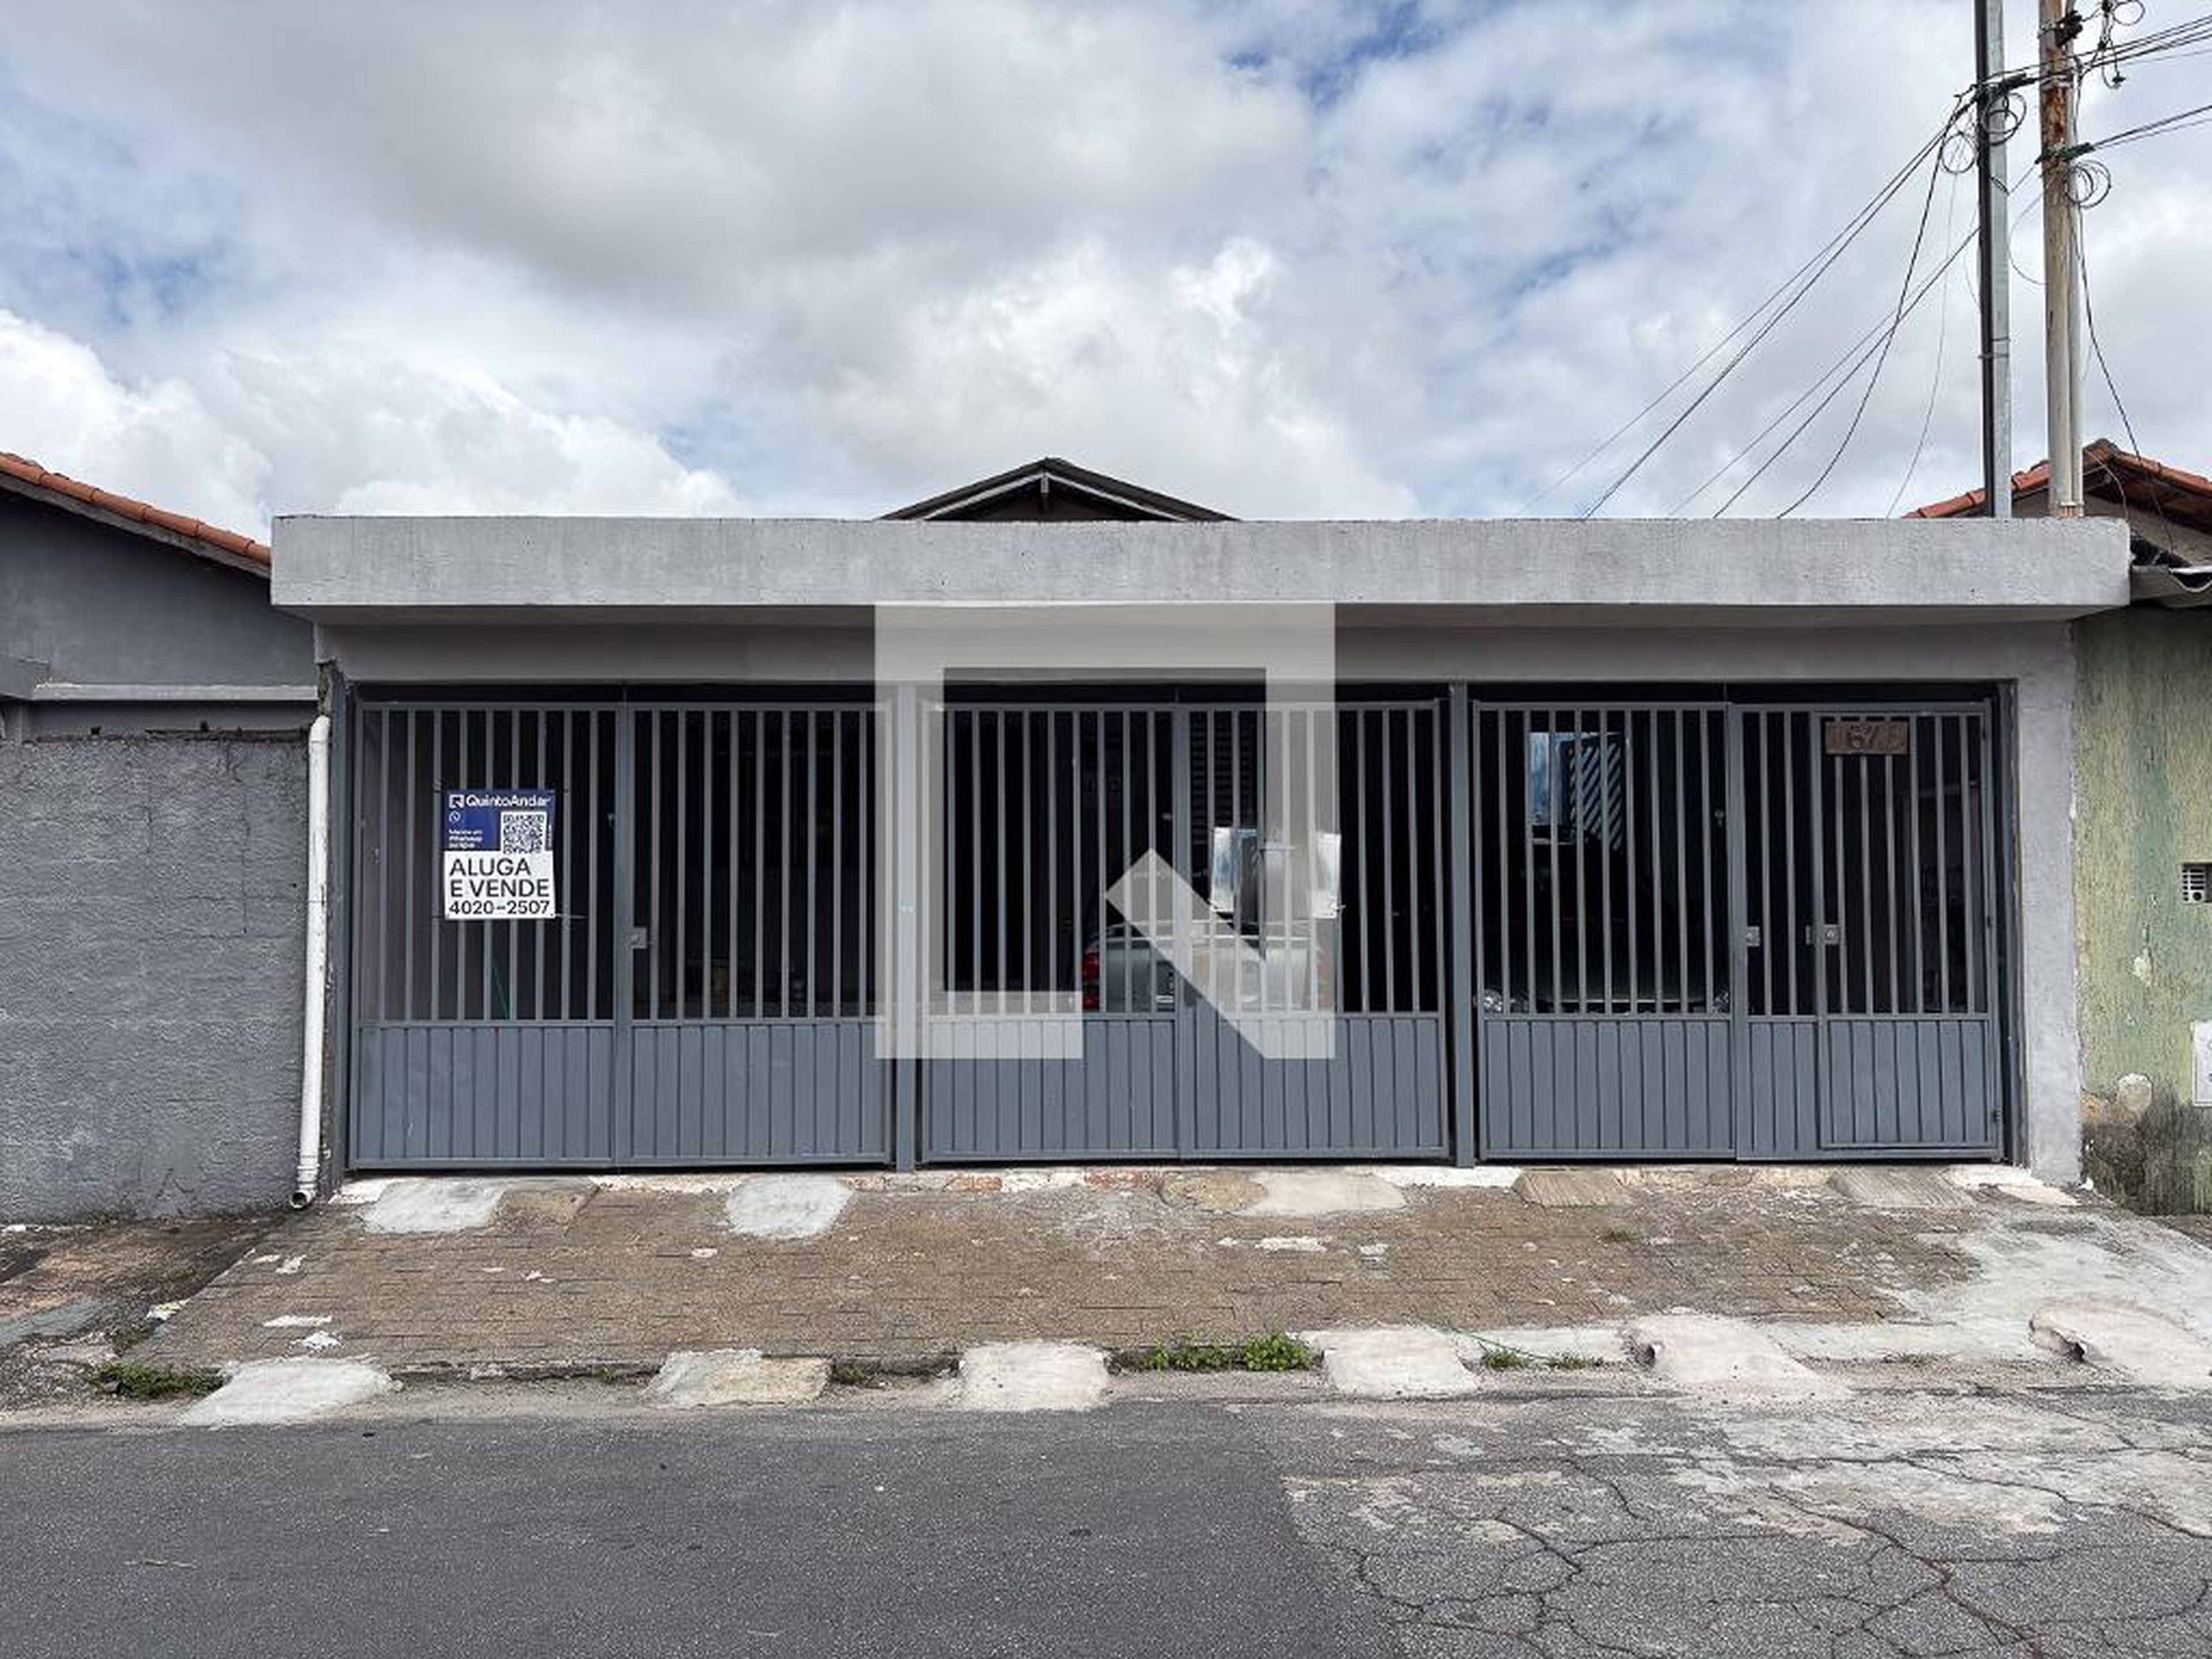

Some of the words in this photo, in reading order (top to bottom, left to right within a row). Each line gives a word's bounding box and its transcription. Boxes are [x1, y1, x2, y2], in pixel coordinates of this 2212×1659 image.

[465, 794, 551, 806] QuintoAndar
[449, 858, 532, 876] ALUGA
[450, 880, 463, 897] E
[469, 879, 550, 897] VENDE
[449, 900, 550, 915] 4020-2507
